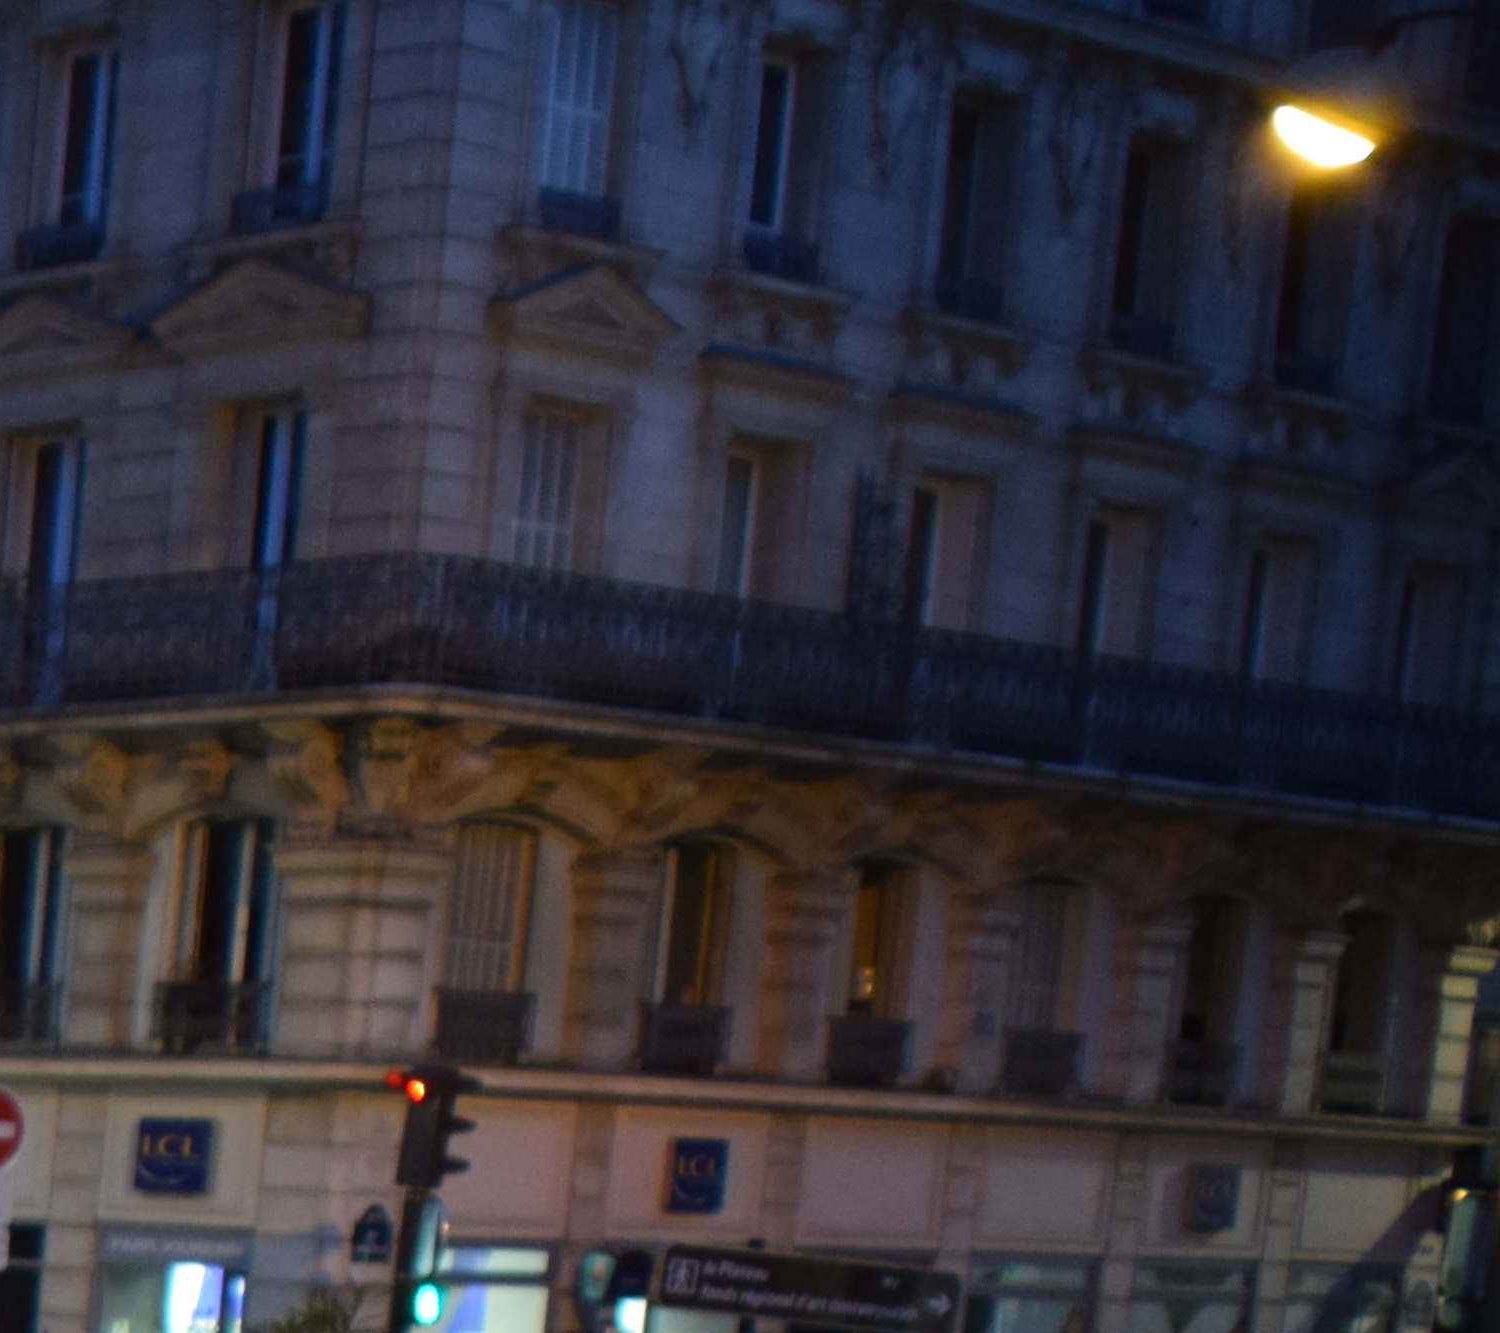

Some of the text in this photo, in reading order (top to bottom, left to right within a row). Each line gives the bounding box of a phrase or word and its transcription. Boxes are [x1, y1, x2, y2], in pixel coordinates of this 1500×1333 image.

[141, 1133, 199, 1160] LCL
[676, 1153, 720, 1179] LCL
[719, 1260, 769, 1282] Plateau
